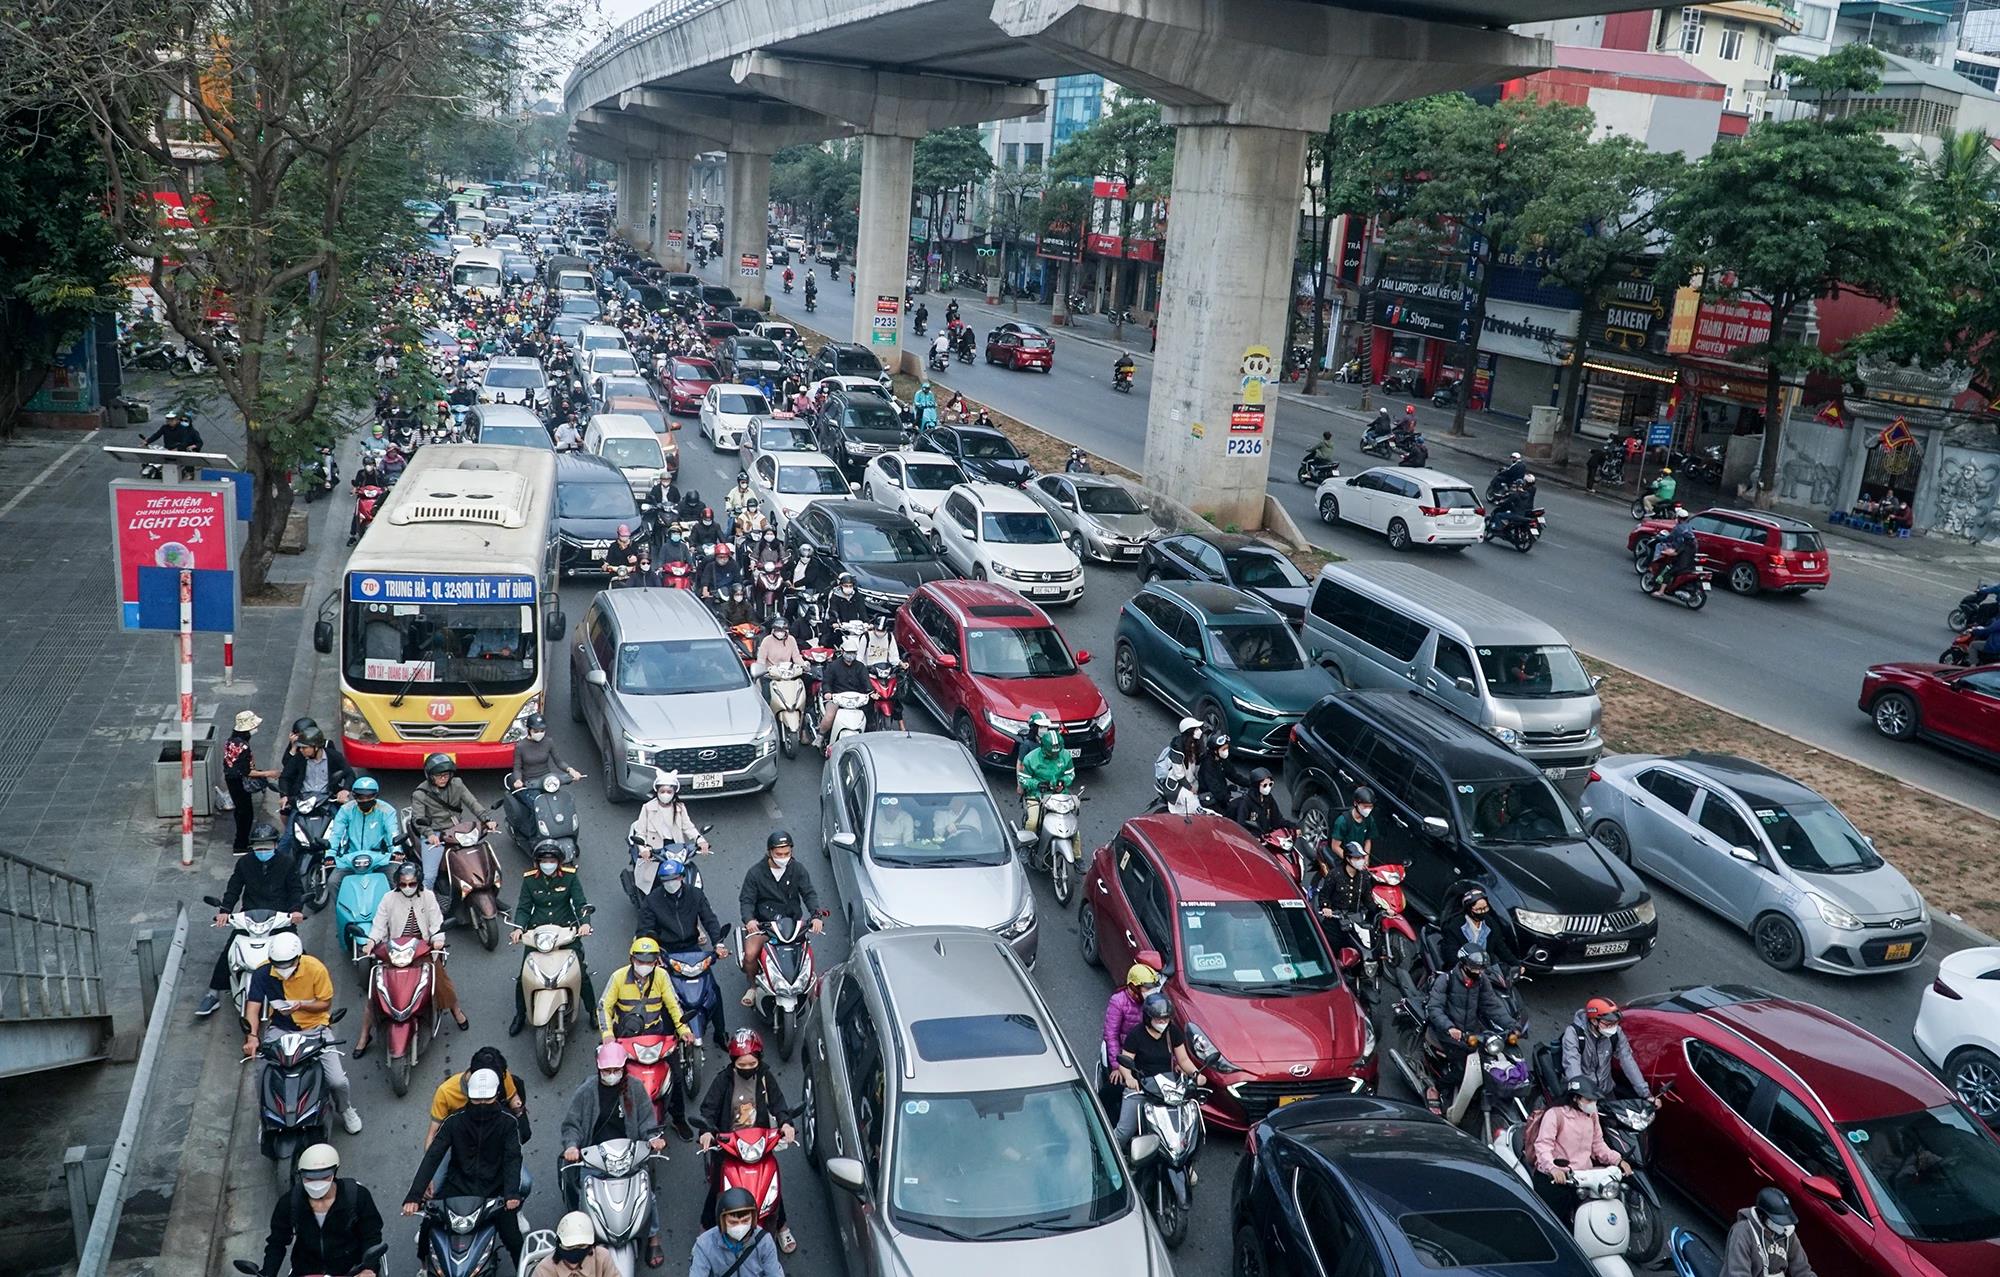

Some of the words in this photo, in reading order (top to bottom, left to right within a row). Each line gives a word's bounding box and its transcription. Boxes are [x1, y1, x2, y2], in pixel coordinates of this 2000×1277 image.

[741, 268, 759, 276] P234
[1394, 281, 1418, 295] LAPTOP
[874, 317, 897, 327] P235
[1607, 308, 1652, 331] BAKERY
[1228, 439, 1262, 454] P236
[147, 497, 171, 508] TIẾT
[172, 497, 202, 508] KIỆM
[129, 517, 178, 530] LIGHT
[178, 516, 214, 528] BOX
[385, 580, 413, 597] TRUNG
[432, 581, 443, 599] QL
[475, 579, 491, 599] TÂY
[498, 579, 511, 599] MỸ
[512, 579, 532, 599] ĐÌNH
[1198, 955, 1224, 967] Grab
